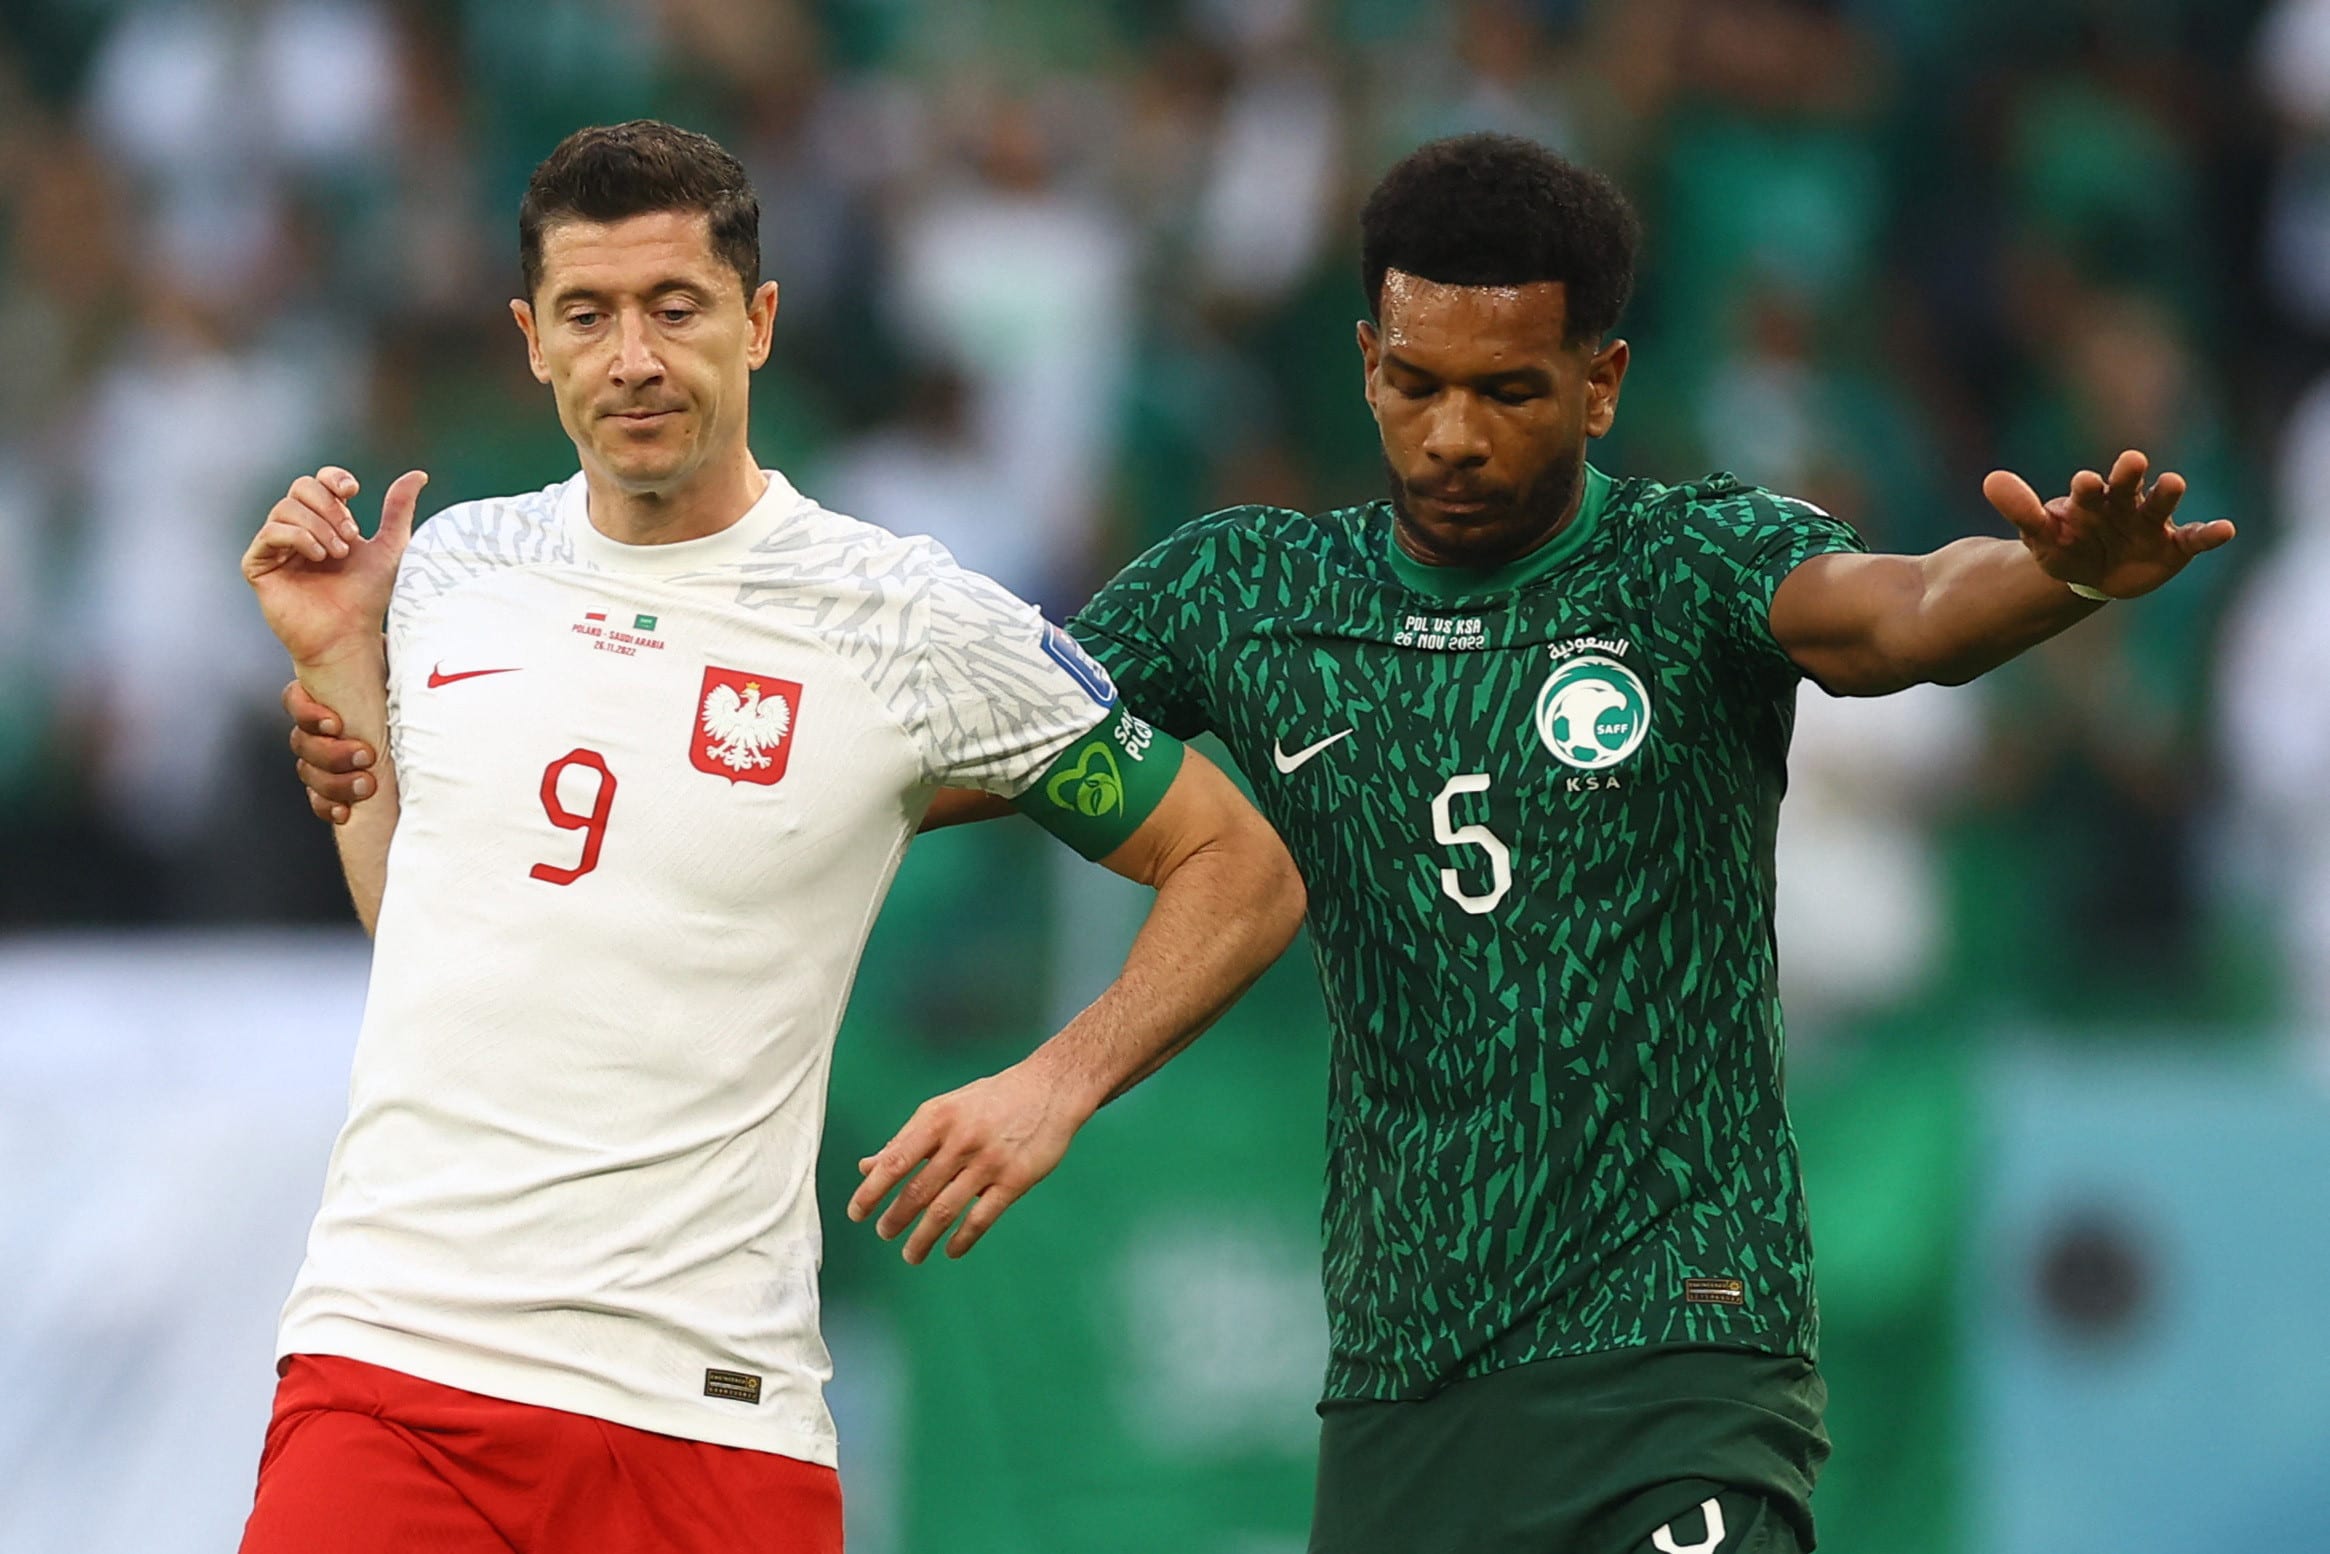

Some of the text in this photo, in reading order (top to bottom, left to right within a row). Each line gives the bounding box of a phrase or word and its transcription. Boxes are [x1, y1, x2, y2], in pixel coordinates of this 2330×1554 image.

[572, 624, 602, 637] POLAND
[609, 631, 634, 643] SAUDI
[635, 637, 665, 650] ARABIA
[1456, 618, 1482, 635] KSA
[593, 640, 637, 657] 26.11.2022
[1394, 631, 1413, 646] 26
[1448, 635, 1485, 651] 2022
[1548, 636, 1629, 660] السعودية
[1597, 723, 1629, 735] SAFF
[529, 747, 618, 886] 9
[1431, 773, 1513, 915] 5
